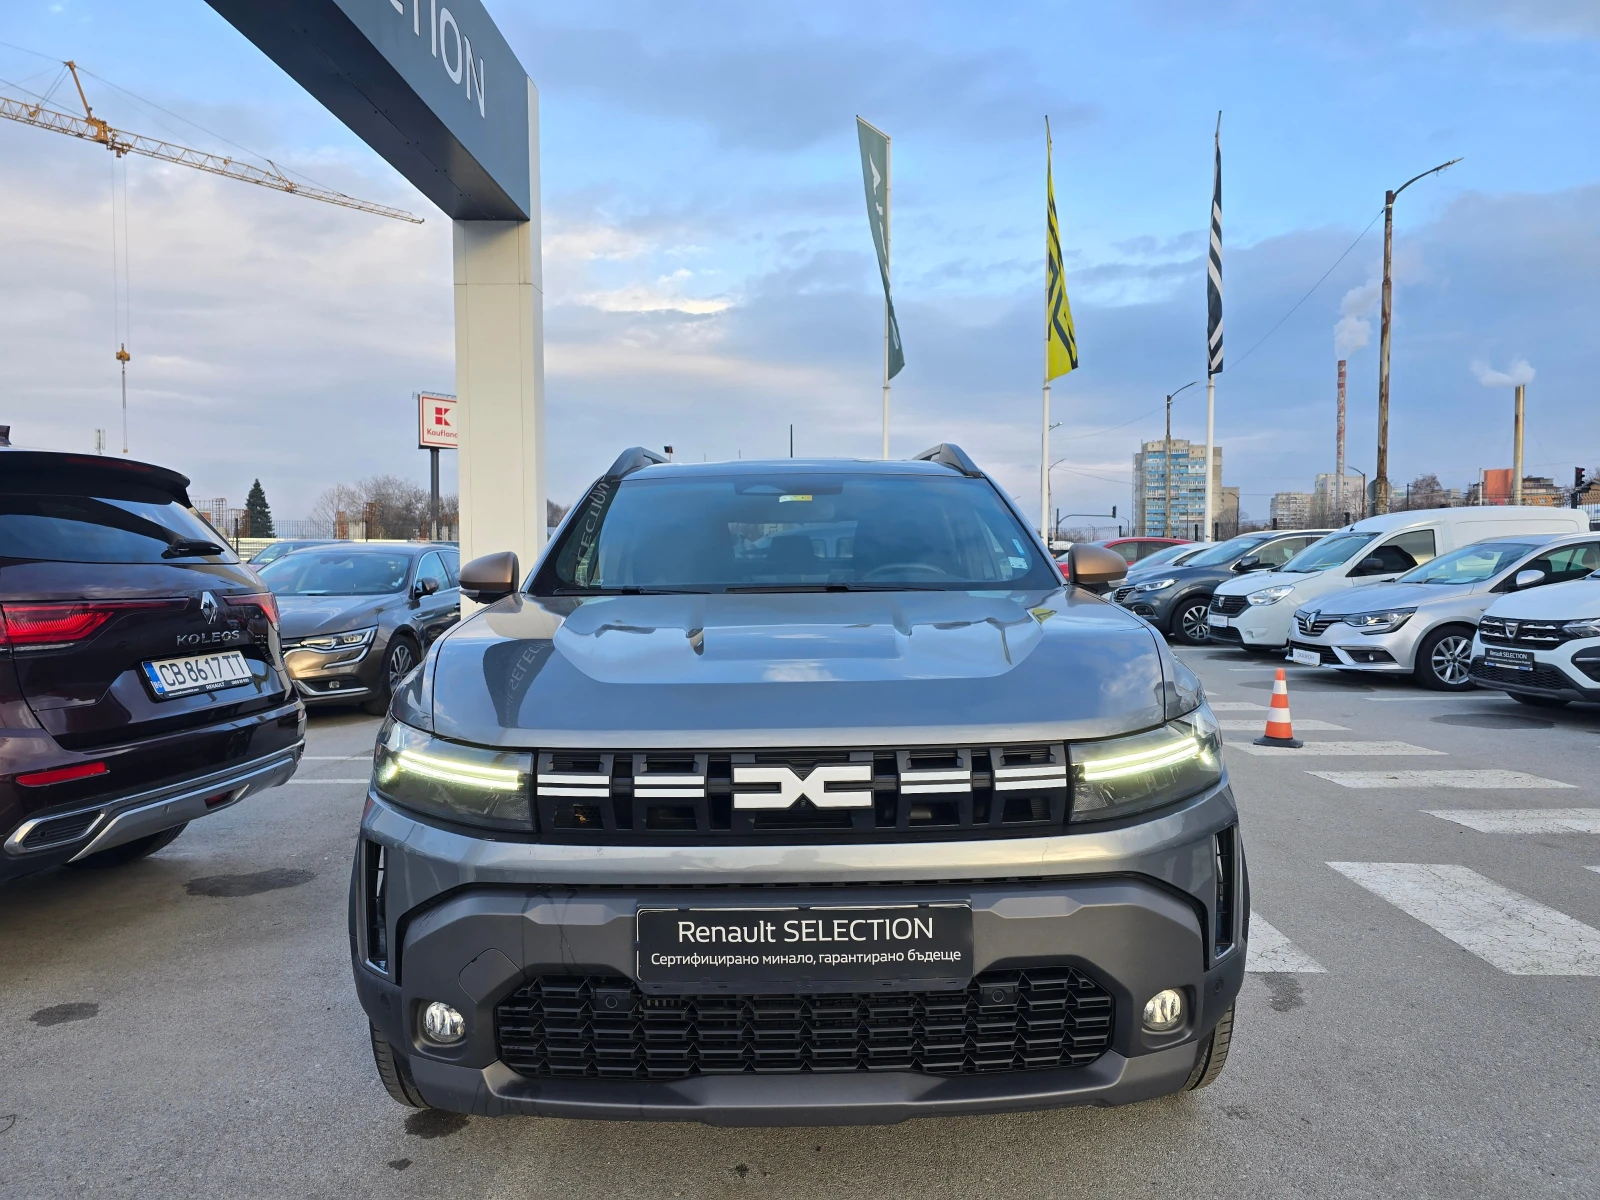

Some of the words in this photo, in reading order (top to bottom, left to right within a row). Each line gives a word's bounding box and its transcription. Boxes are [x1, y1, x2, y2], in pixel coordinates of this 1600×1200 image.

[390, 0, 486, 119] ION
[176, 630, 240, 646] KOLEOS
[677, 920, 777, 943] Renault
[783, 917, 933, 943] SELECTION
[651, 952, 759, 968] Сертифицирано
[762, 953, 817, 966] минало,
[818, 950, 905, 966] гарантирано
[907, 949, 962, 963] бъдеще
